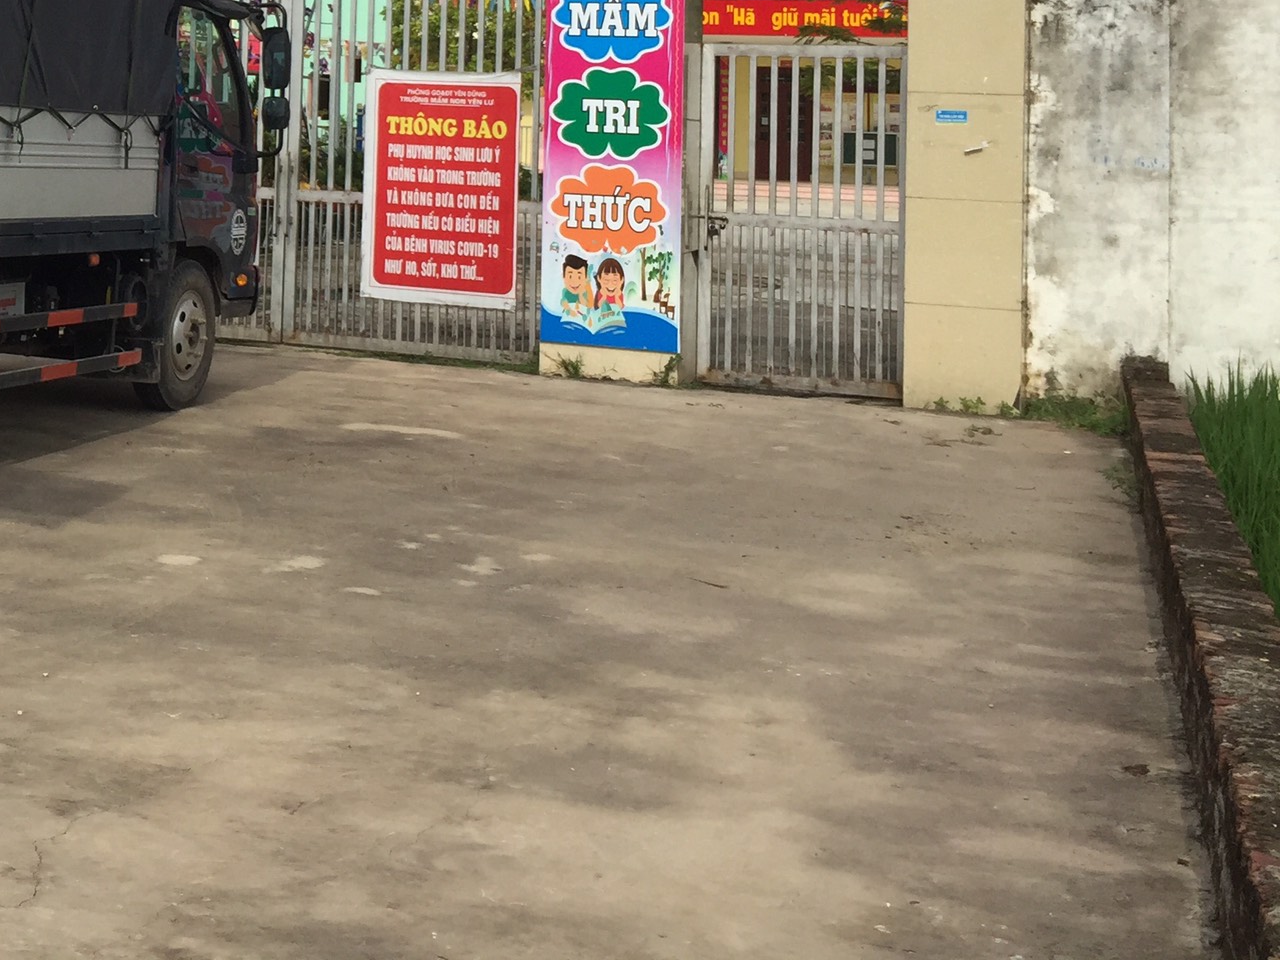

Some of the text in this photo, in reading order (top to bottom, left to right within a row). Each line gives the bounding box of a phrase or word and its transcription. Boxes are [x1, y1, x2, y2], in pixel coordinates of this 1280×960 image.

[771, 7, 799, 31] giữ
[804, 7, 836, 27] mãi
[842, 3, 878, 26] tuổi
[386, 112, 508, 140] THÔNG BÁO
[582, 98, 640, 134] TRI
[388, 143, 501, 164] PHỤ HUYNH HỌC SINH LƯU Ý
[387, 164, 501, 187] KHÔNG VÀO TRONG TRƯỜNG
[386, 187, 500, 211] VÀ KHÔNG ĐƯA CON ĐẾN
[563, 185, 651, 233] THỨC
[386, 210, 500, 237] TRƯỜNG NẾU CÓ BIỂU HIỆN
[385, 230, 499, 259] CỦA BỆNH VIRUS COVID-19
[384, 259, 403, 274] NHƯ
[405, 260, 419, 278] HO,
[421, 257, 439, 279] SỐT,
[441, 261, 458, 279] KHÓ
